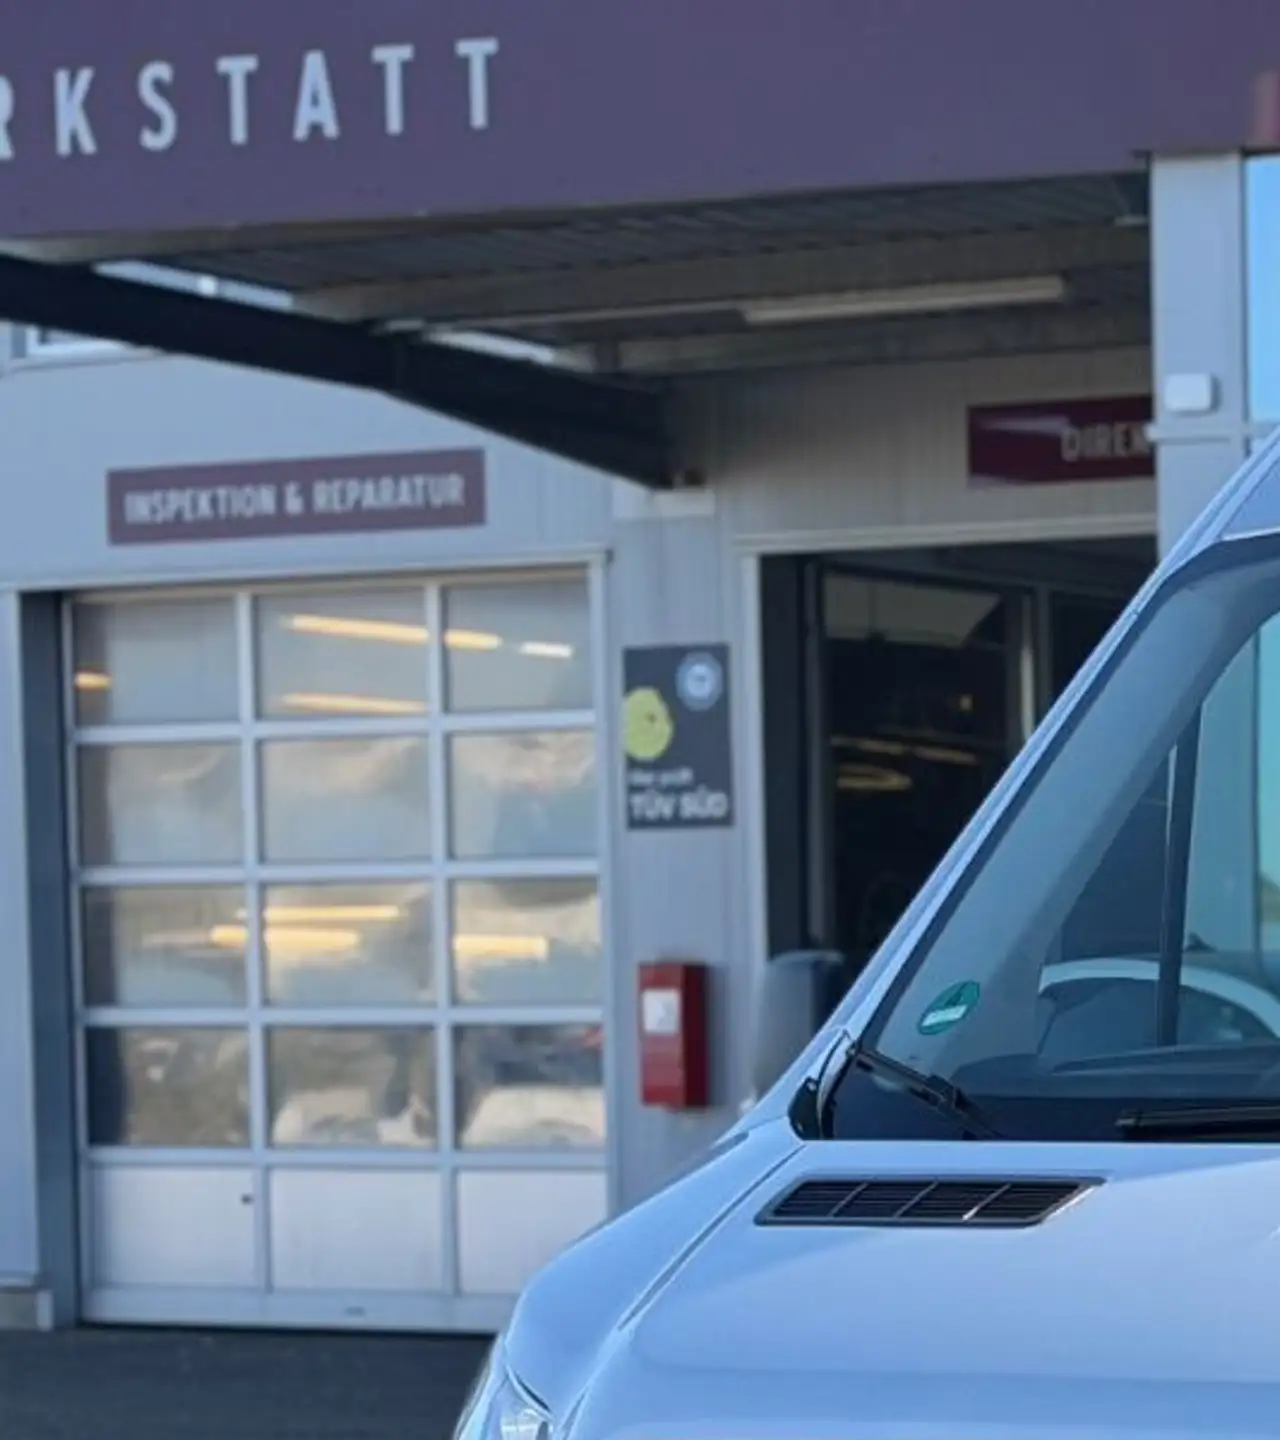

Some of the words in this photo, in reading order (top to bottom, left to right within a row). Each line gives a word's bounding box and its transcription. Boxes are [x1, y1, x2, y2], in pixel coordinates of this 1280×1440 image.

[124, 484, 277, 524] INSPEKTION
[284, 480, 305, 516] &
[311, 473, 465, 514] REPARATUR
